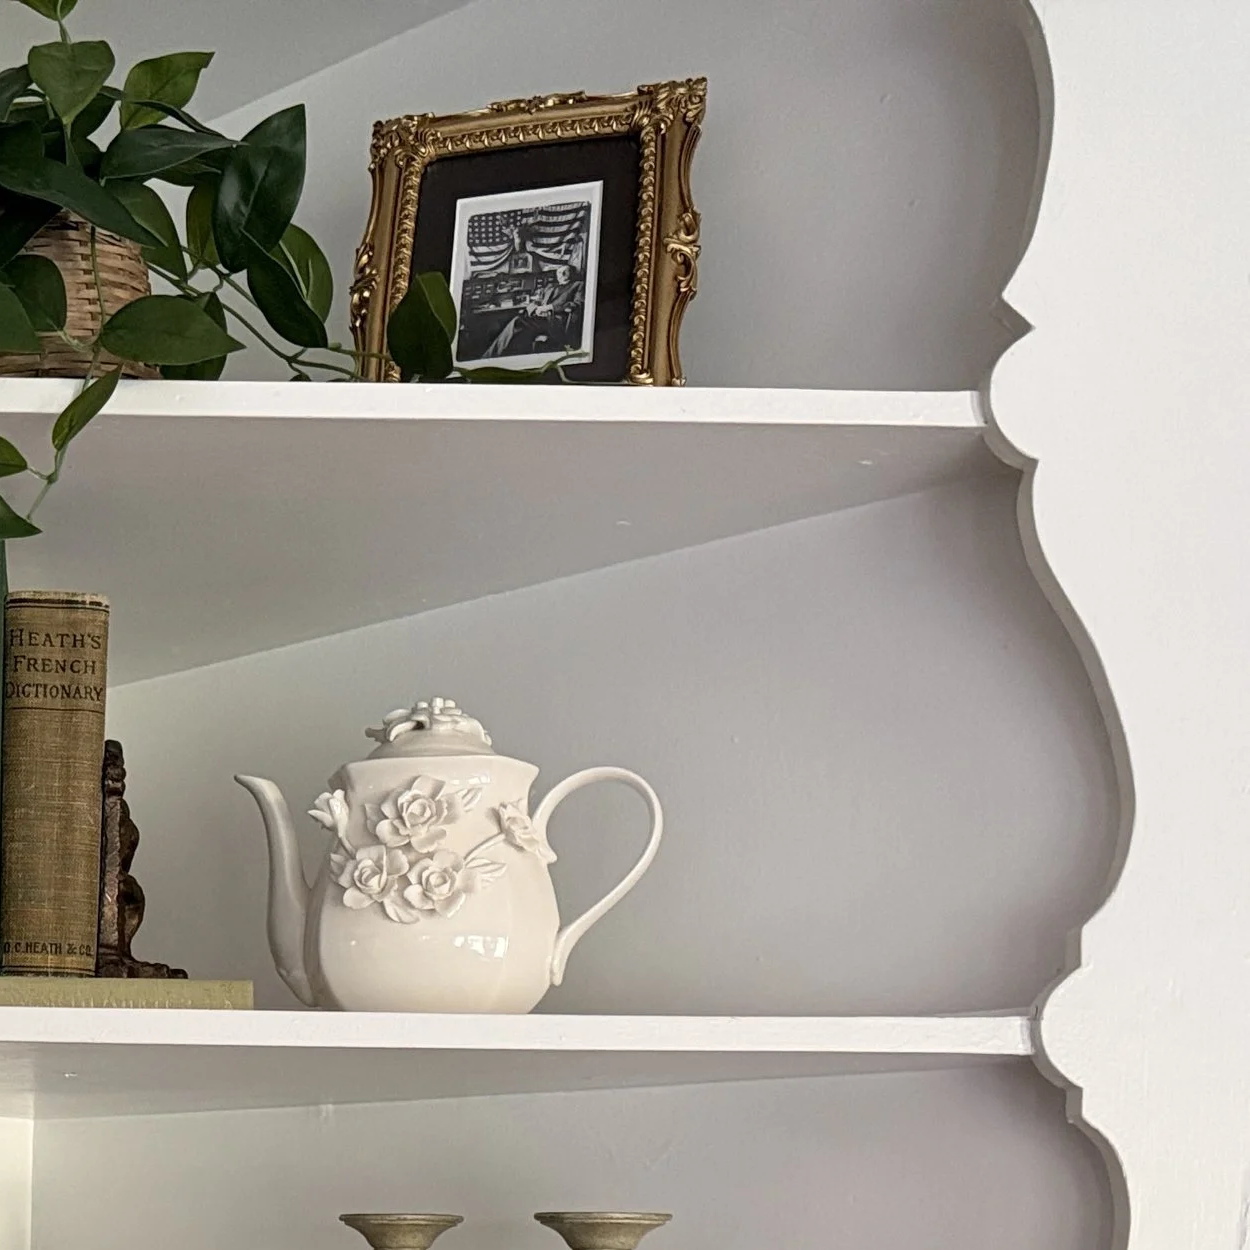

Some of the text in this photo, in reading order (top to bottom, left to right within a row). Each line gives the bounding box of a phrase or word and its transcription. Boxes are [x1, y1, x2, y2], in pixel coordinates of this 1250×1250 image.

[9, 628, 101, 650] HEATH'S
[13, 654, 97, 675] FRENCH
[5, 681, 103, 702] DICTIONARY
